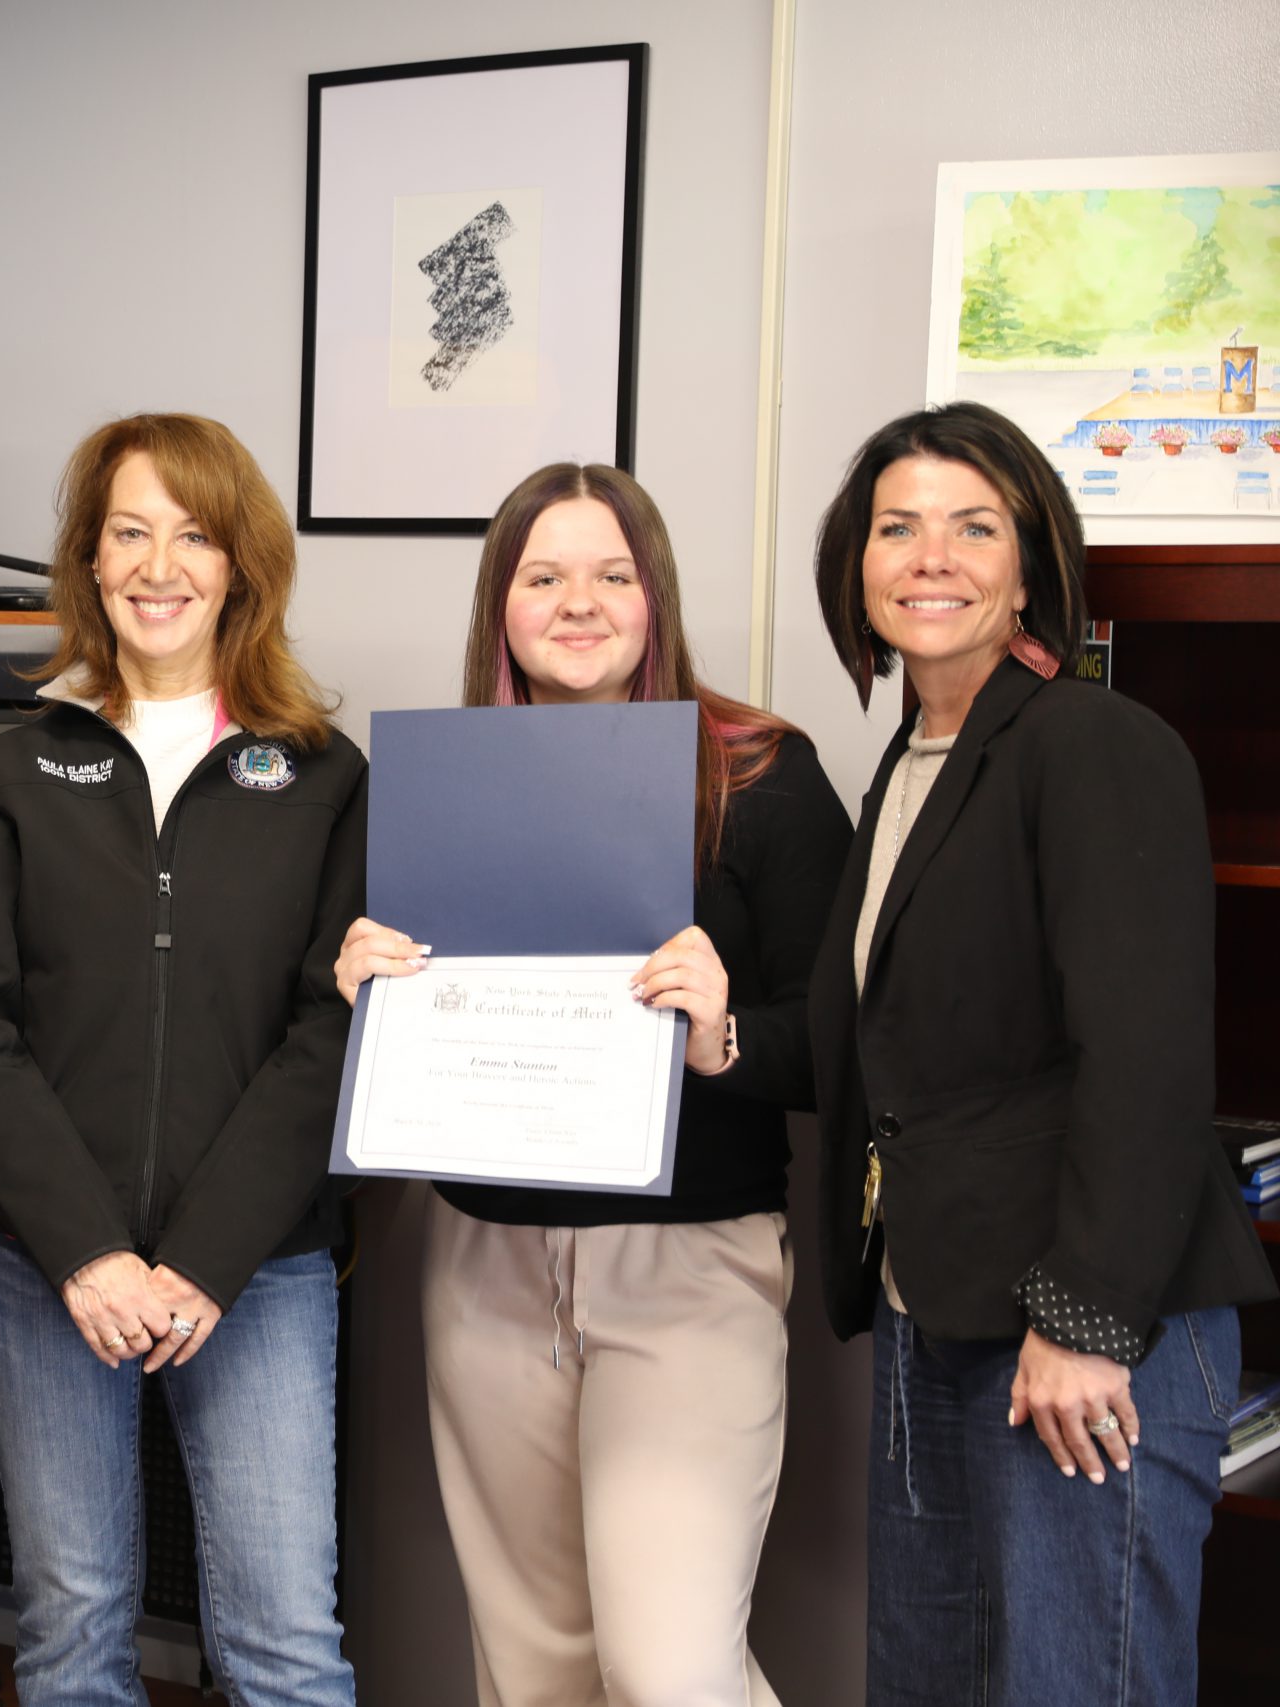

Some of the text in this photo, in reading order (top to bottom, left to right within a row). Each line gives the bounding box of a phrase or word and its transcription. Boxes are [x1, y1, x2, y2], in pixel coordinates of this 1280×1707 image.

[1222, 358, 1254, 394] M
[37, 756, 114, 774] PAULA ELAINE KAY
[69, 770, 112, 783] DISTRICT
[484, 985, 608, 1001] New York State Assembly
[475, 1001, 613, 1020] Certificate of Merit
[469, 1056, 558, 1071] Emma Stanton
